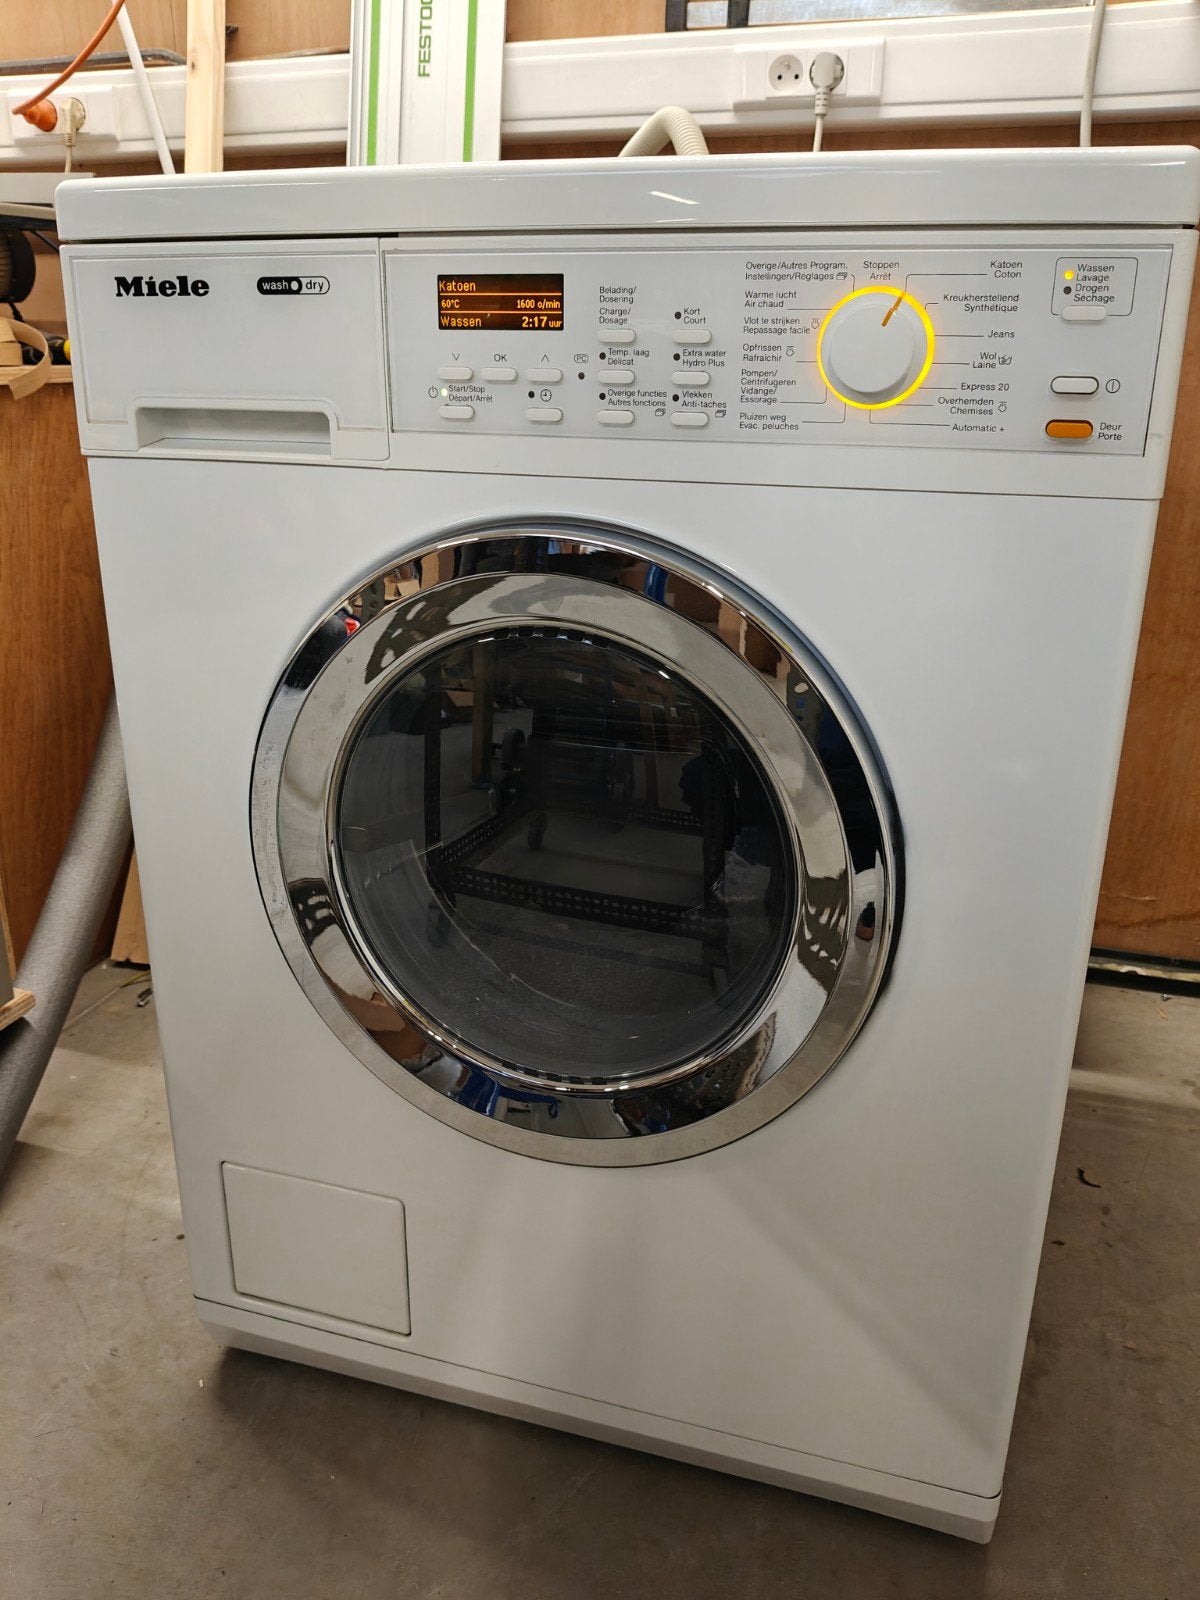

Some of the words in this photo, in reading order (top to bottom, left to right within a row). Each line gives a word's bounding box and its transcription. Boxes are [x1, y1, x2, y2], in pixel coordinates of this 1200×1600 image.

[746, 262, 807, 270] Overige/Autres
[810, 262, 848, 270] Program.
[863, 261, 900, 270] Stoppen
[990, 260, 1023, 269] Katoen
[1077, 264, 1114, 272] Wassen
[870, 273, 891, 281] Arrêt
[994, 270, 1022, 278] Coton
[1076, 274, 1110, 283] Lavage
[114, 276, 210, 297] Miele
[262, 280, 288, 290] wash
[306, 279, 324, 292] dry
[439, 280, 476, 292] Katoen
[1075, 284, 1109, 294] Drogen
[599, 286, 636, 295] Belading/
[599, 295, 634, 304] Dosering
[943, 294, 1019, 302] Kreukherstellend
[1074, 293, 1114, 303] Séchage
[516, 300, 534, 308] 1600
[538, 299, 560, 309] o/min
[964, 303, 1018, 313] Synthétique
[599, 308, 631, 316] Charge/
[440, 316, 482, 327] Wassen
[522, 316, 548, 328] 2:17
[549, 320, 562, 328] uur
[599, 316, 628, 325] Dosage
[683, 316, 706, 324] Court
[771, 317, 800, 326] strijken
[743, 327, 788, 335] Repassage
[988, 330, 1015, 339] Jeans
[742, 344, 782, 352] Opfrissen
[608, 348, 631, 358] Temp.
[633, 348, 649, 357] laag
[980, 352, 997, 360] Wol
[494, 354, 507, 362] OK
[608, 357, 634, 365] Délicat
[682, 359, 706, 368] Hydro
[972, 361, 996, 369] Laine
[741, 369, 778, 378] Pompen/
[740, 378, 796, 387] Centrifugeren
[448, 385, 485, 394] Start/Stop
[740, 387, 778, 396] Vidange/
[961, 383, 996, 392] Express
[998, 383, 1009, 391] 20
[608, 389, 636, 398] Overige
[637, 390, 667, 398] functies
[632, 398, 666, 406] fonctions
[682, 400, 727, 408] Anti-taches
[740, 396, 777, 404] Essorage
[938, 397, 994, 406] Overhemden
[950, 407, 993, 416] Chemises
[769, 414, 786, 422] weg
[762, 422, 799, 431] peluches
[952, 424, 997, 433] Automatic
[1100, 422, 1122, 431] Deur
[1098, 432, 1122, 441] Porte
